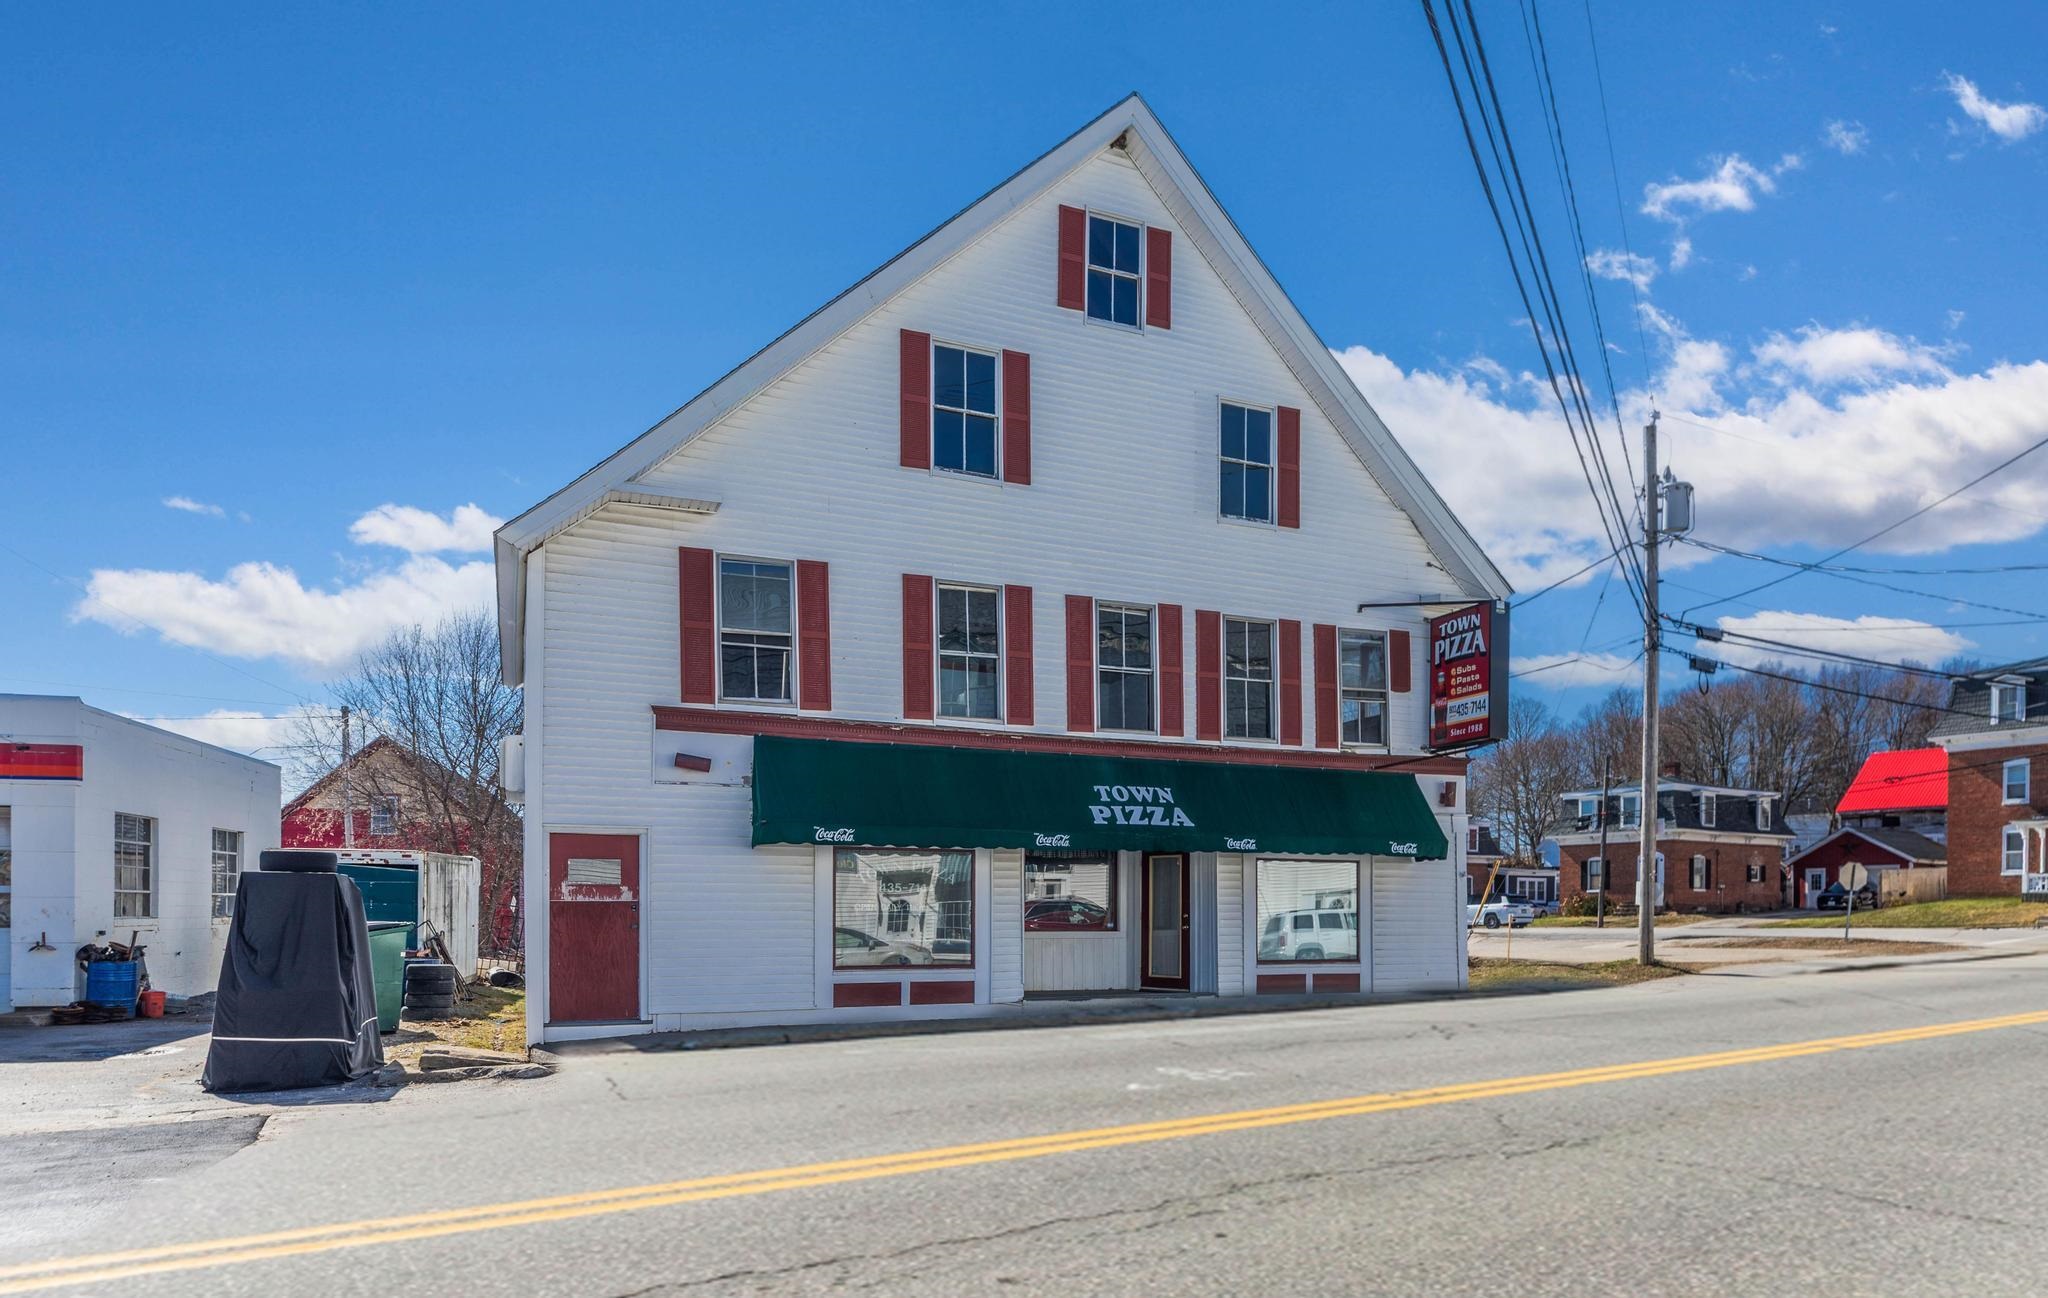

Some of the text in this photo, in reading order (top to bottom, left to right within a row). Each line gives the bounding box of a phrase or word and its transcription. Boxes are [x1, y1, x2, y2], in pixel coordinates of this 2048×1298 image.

[1439, 613, 1481, 637] TOWN
[1435, 629, 1487, 665] PIZZA
[1456, 664, 1477, 675] Subs
[1456, 673, 1480, 685] Pasta
[1456, 683, 1483, 695] Salads
[1450, 723, 1484, 737] Since 1988
[1093, 785, 1175, 804] TOWN
[1088, 805, 1195, 827] PIZZA
[815, 827, 856, 842] Coca-Cola
[1036, 833, 1071, 847] Coca-Cola
[1226, 838, 1257, 850] Coca-Cola
[1391, 842, 1418, 854] Coca-Cola
